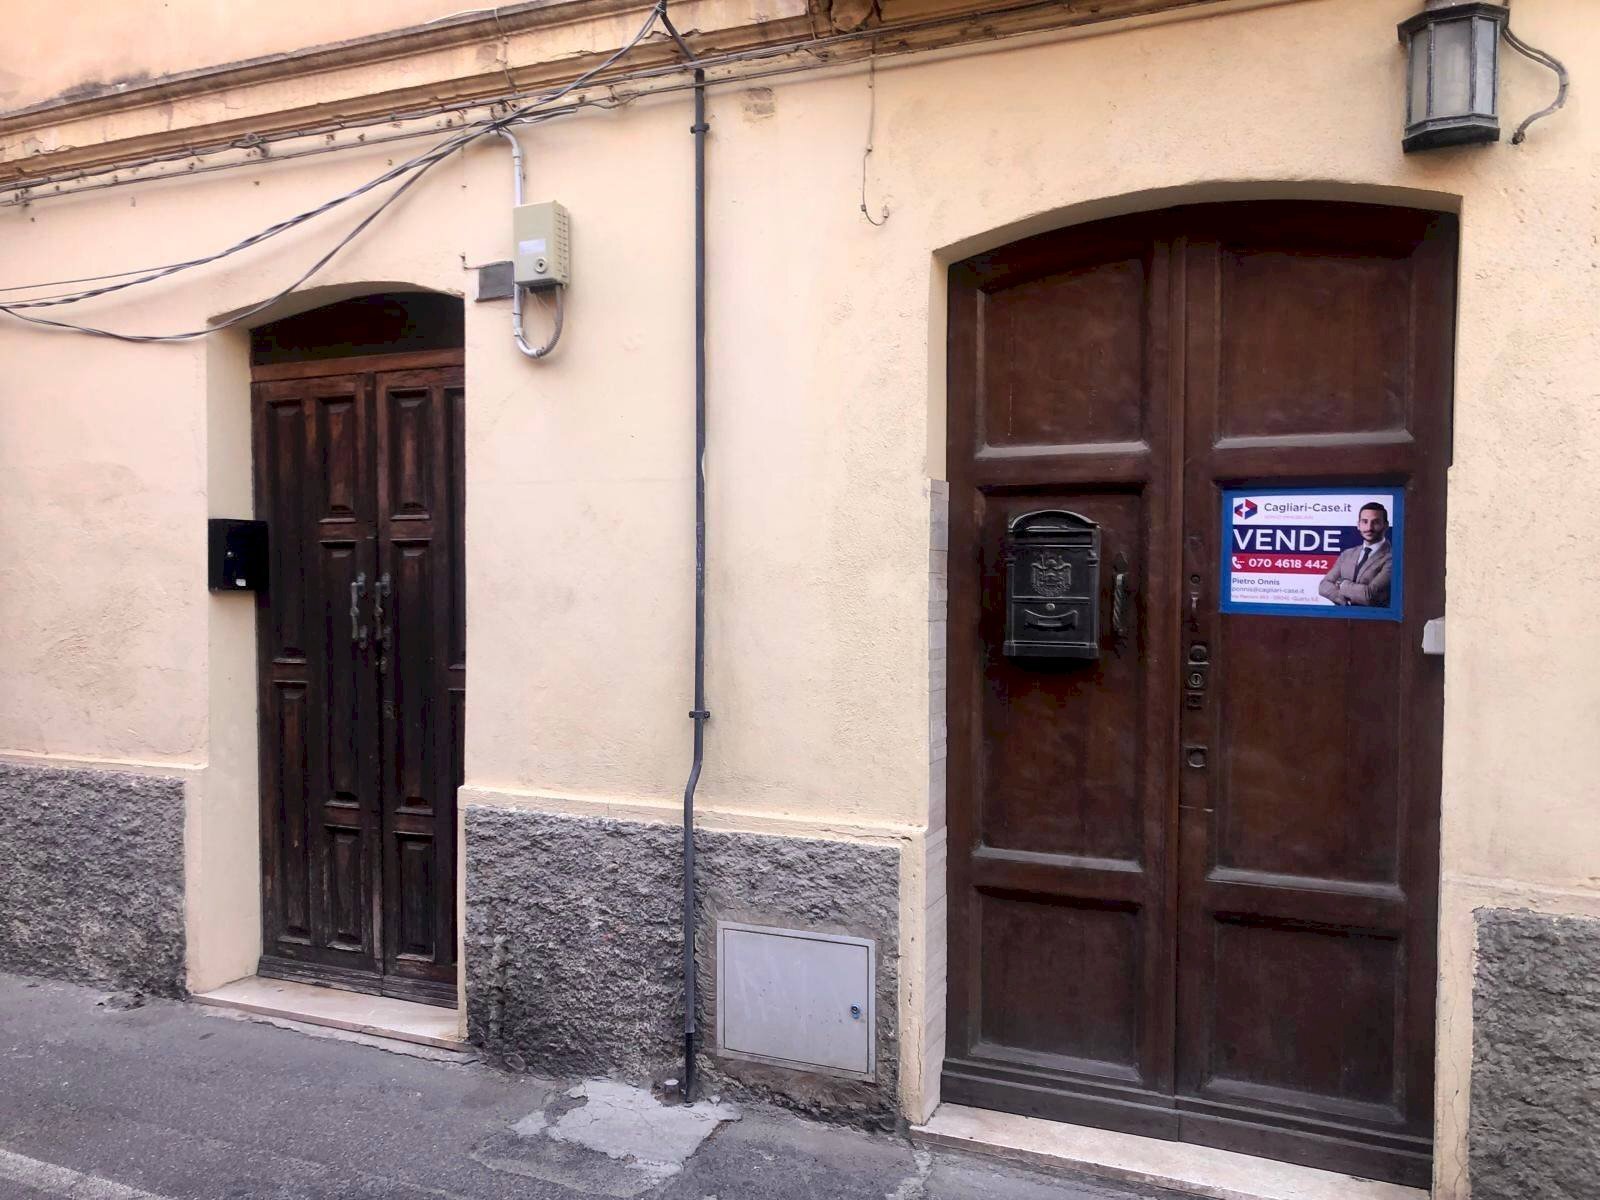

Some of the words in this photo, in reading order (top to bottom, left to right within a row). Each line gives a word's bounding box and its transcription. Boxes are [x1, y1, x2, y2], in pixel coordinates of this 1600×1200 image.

[1264, 502, 1352, 513] Cagliari-Case.it
[1232, 529, 1341, 552] VENDE
[1248, 558, 1272, 568] 070
[1274, 558, 1302, 569] 4618
[1304, 559, 1328, 569] 442
[1232, 577, 1256, 585] Pietro
[1257, 578, 1280, 586] Onnis
